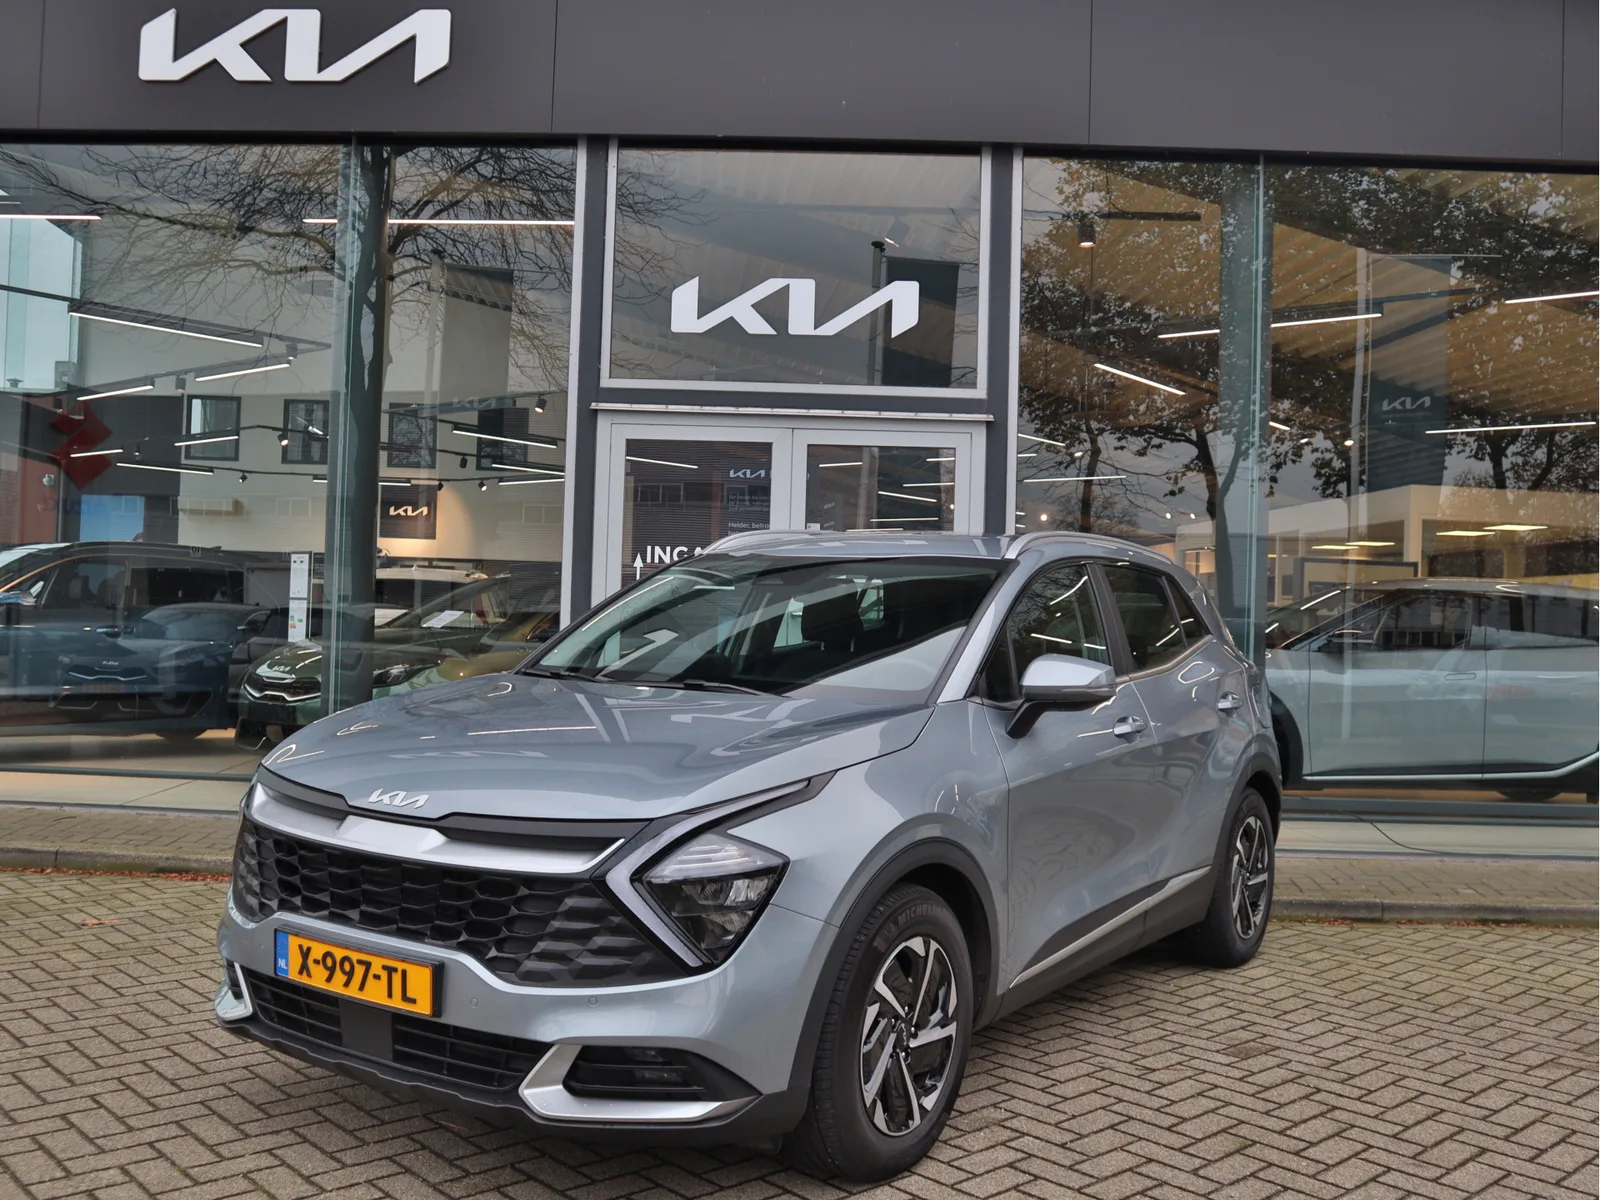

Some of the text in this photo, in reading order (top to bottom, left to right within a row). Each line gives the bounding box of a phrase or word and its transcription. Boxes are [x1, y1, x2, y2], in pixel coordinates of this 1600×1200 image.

[139, 8, 452, 85] KIA
[671, 276, 920, 339] KIA
[1382, 396, 1431, 410] KIA
[729, 468, 766, 478] KIA
[389, 505, 428, 517] KIA
[368, 788, 430, 809] KIA
[278, 943, 417, 1004] NL X-997-TL
